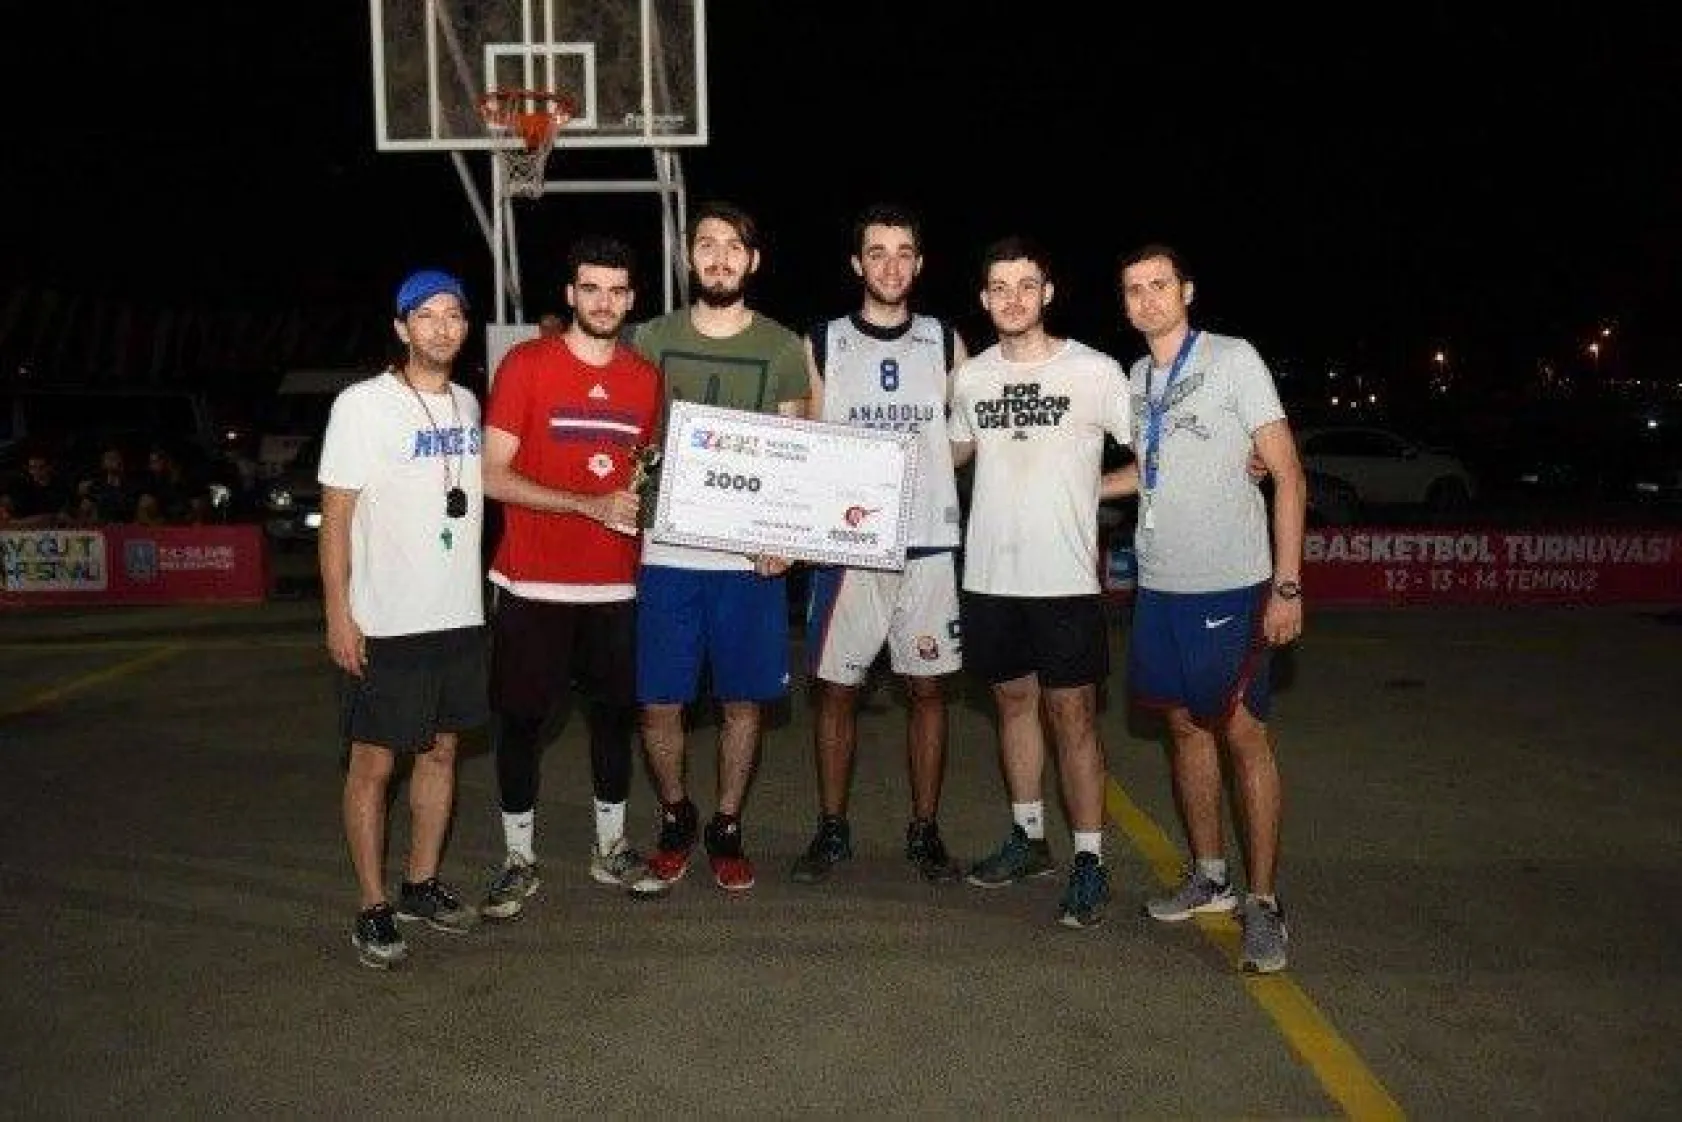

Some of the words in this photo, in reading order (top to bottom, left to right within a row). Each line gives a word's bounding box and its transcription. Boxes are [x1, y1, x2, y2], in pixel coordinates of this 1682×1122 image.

[880, 359, 899, 392] 8
[1003, 383, 1041, 398] FOR
[849, 404, 933, 420] ANADOLU
[974, 396, 1070, 413] OUTDOOR
[977, 413, 1011, 428] USE
[1014, 410, 1064, 427] ONLY
[414, 427, 463, 456] NIKE
[704, 470, 762, 492] 2000
[1303, 536, 1494, 562] BASKETBOL
[1384, 569, 1408, 590] 12
[1504, 568, 1600, 590] TEMMUZ
